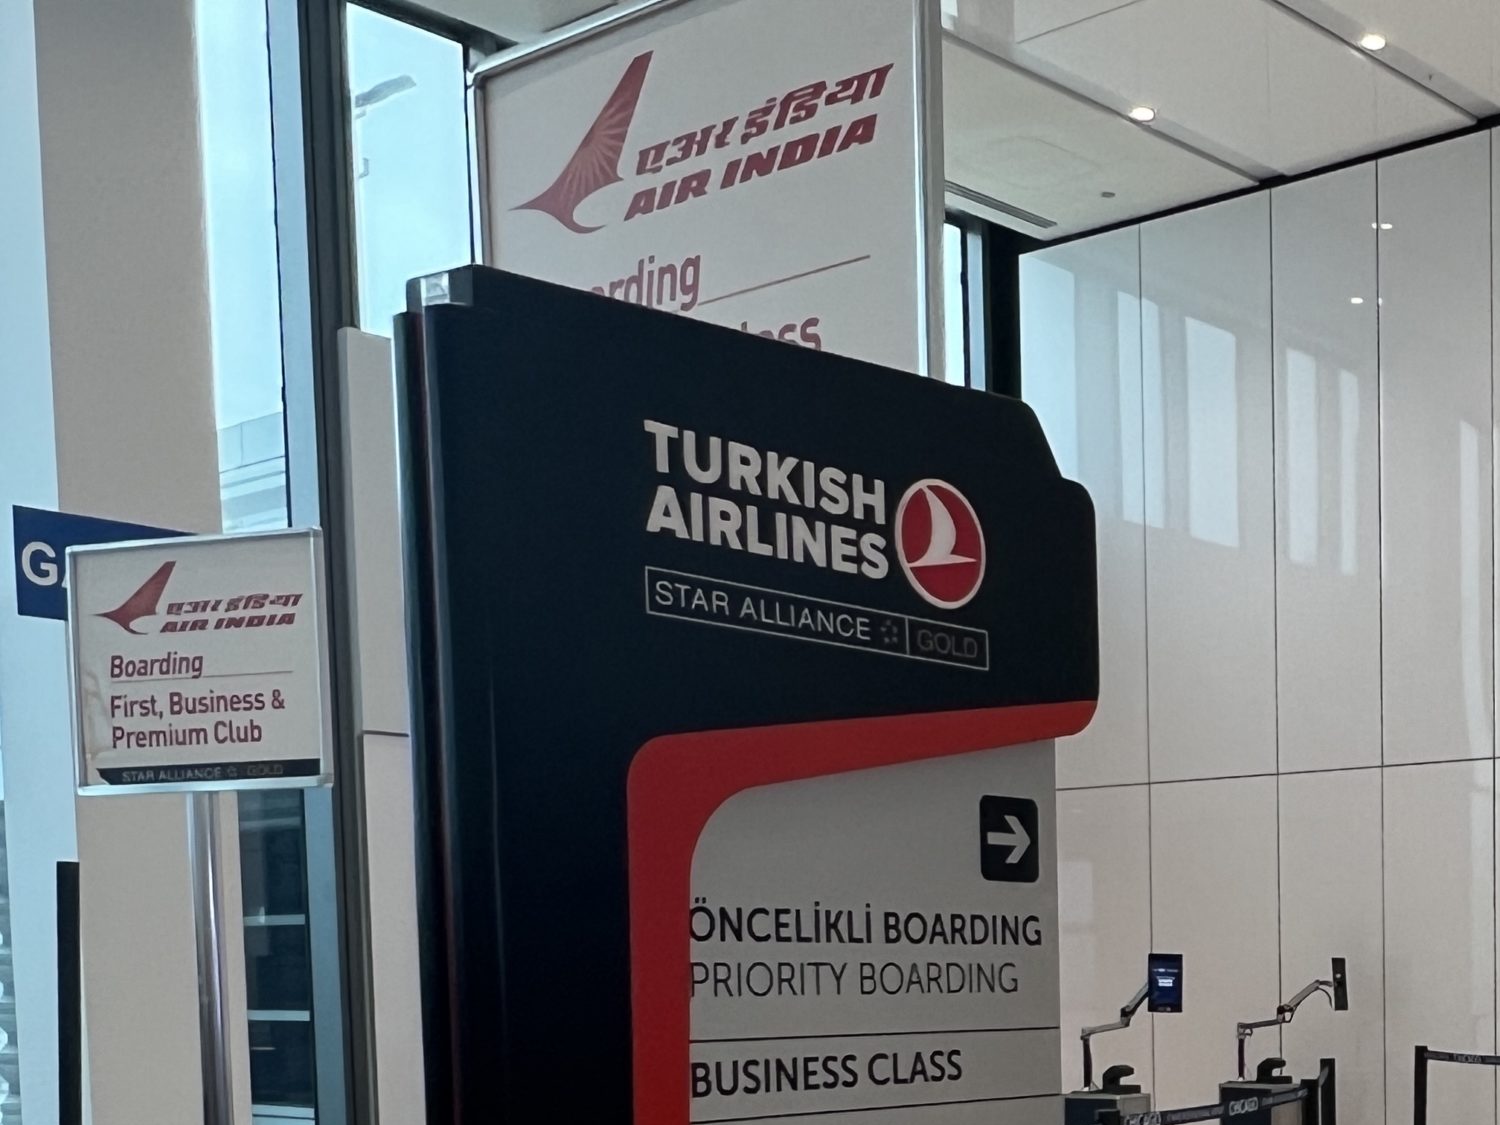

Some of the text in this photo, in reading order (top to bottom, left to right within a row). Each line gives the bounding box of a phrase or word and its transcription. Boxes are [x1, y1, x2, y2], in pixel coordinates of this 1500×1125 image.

[743, 63, 894, 143] इंडिया
[625, 114, 877, 221] AIR INDIA
[592, 255, 700, 312] rding
[643, 419, 886, 525] TURKISH
[646, 485, 889, 580] AIRLINES
[160, 613, 296, 633] AIR INDIA
[655, 580, 978, 660] STAR ALLIANCE GOLD
[111, 651, 203, 679] Boarding
[111, 689, 286, 720] First, Business &
[112, 719, 262, 749] Premium Club
[122, 770, 155, 782] STAR
[159, 767, 221, 781] ALLIANCE
[689, 897, 1042, 946] ÖNCELİKLİ BOARDING
[690, 961, 1018, 997] PRIORITY BOARDING
[691, 1049, 963, 1098] BUSINESS CLASS
